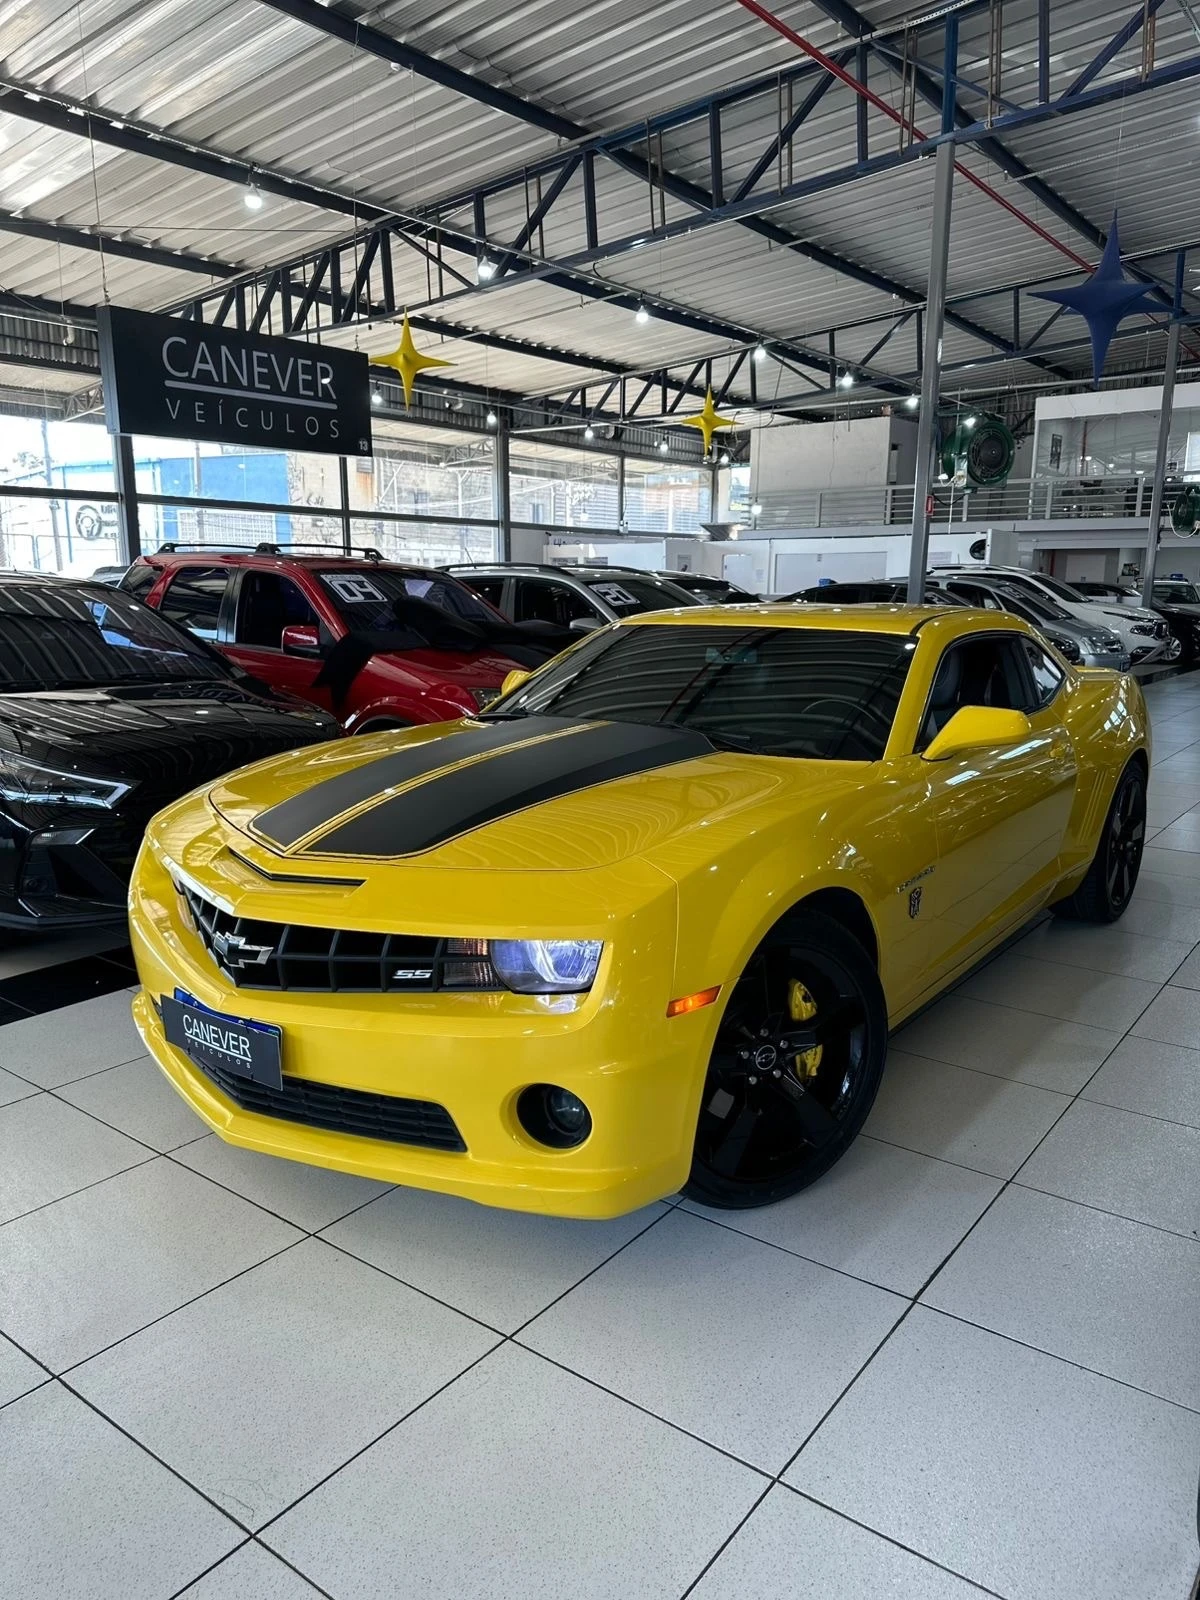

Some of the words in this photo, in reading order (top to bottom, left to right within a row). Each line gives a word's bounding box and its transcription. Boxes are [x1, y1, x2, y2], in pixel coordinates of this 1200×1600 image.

[162, 336, 337, 399] CANEVER
[166, 398, 340, 438] VEÍCULOS
[331, 581, 383, 601] 04
[183, 1014, 252, 1058] CANEVER
